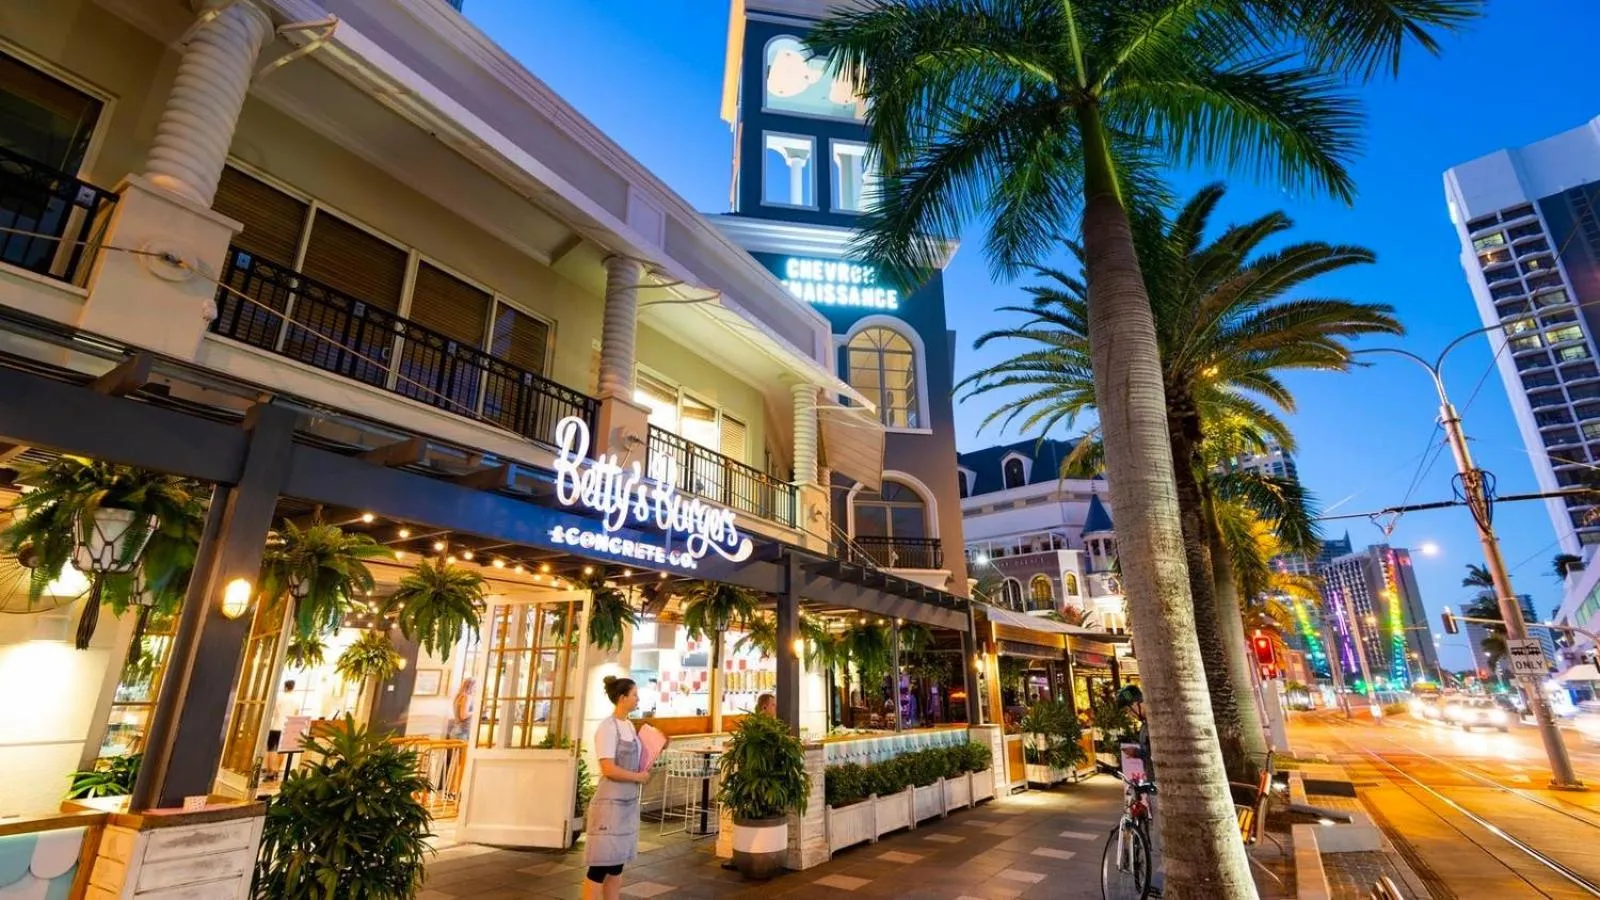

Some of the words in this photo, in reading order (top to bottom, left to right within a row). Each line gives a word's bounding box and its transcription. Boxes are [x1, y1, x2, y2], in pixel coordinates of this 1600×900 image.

[780, 279, 898, 310] NAISSANCE
[553, 416, 649, 532] Betty's
[651, 452, 753, 562] Burgers
[669, 550, 698, 570] CO.
[1515, 661, 1543, 670] ONLY
